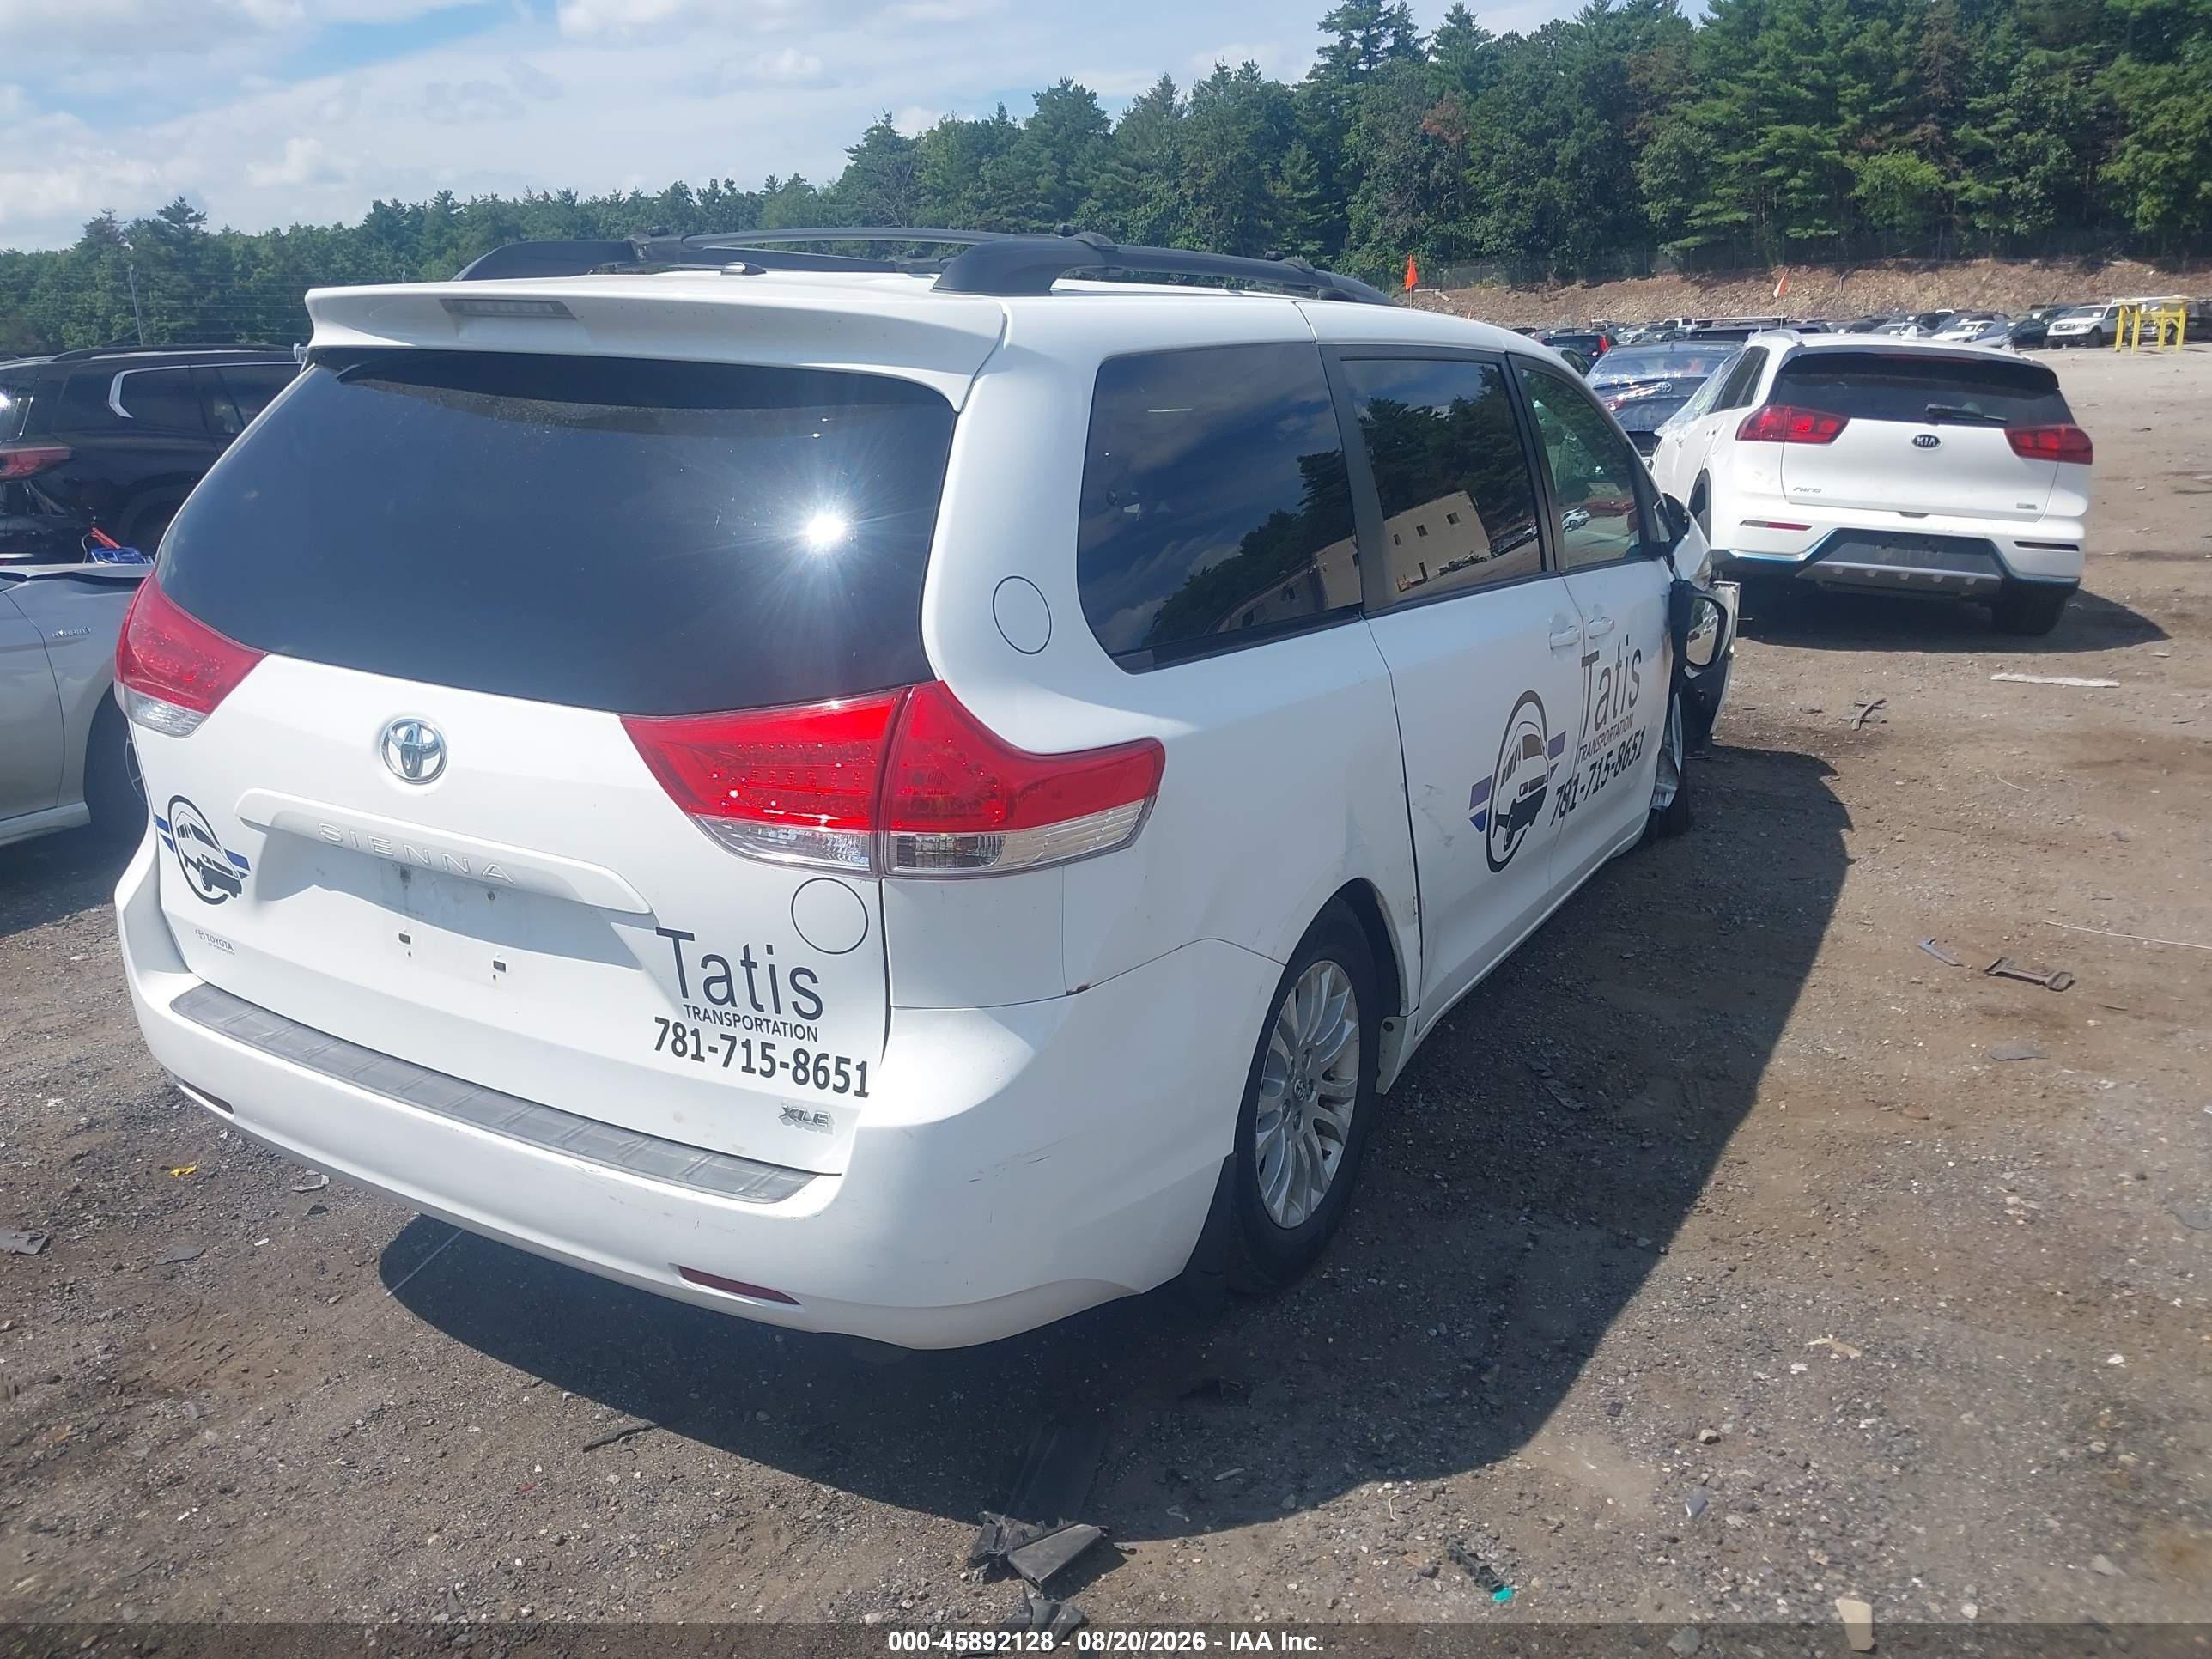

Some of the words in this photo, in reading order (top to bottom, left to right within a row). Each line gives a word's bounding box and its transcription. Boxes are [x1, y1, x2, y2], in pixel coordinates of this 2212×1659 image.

[1915, 436, 1937, 447] KIA
[1581, 634, 1642, 739] Tatis
[1577, 713, 1634, 764] TRANSPORTATION
[1549, 726, 1646, 827] 781-715-8651
[317, 822, 516, 885] SIENNA
[205, 933, 234, 951] TOYOTA
[655, 927, 824, 1021] Tatis
[683, 1004, 818, 1042] TRANSPORTATION
[653, 1016, 870, 1098] 781-715-8651
[777, 1105, 831, 1127] XLE
